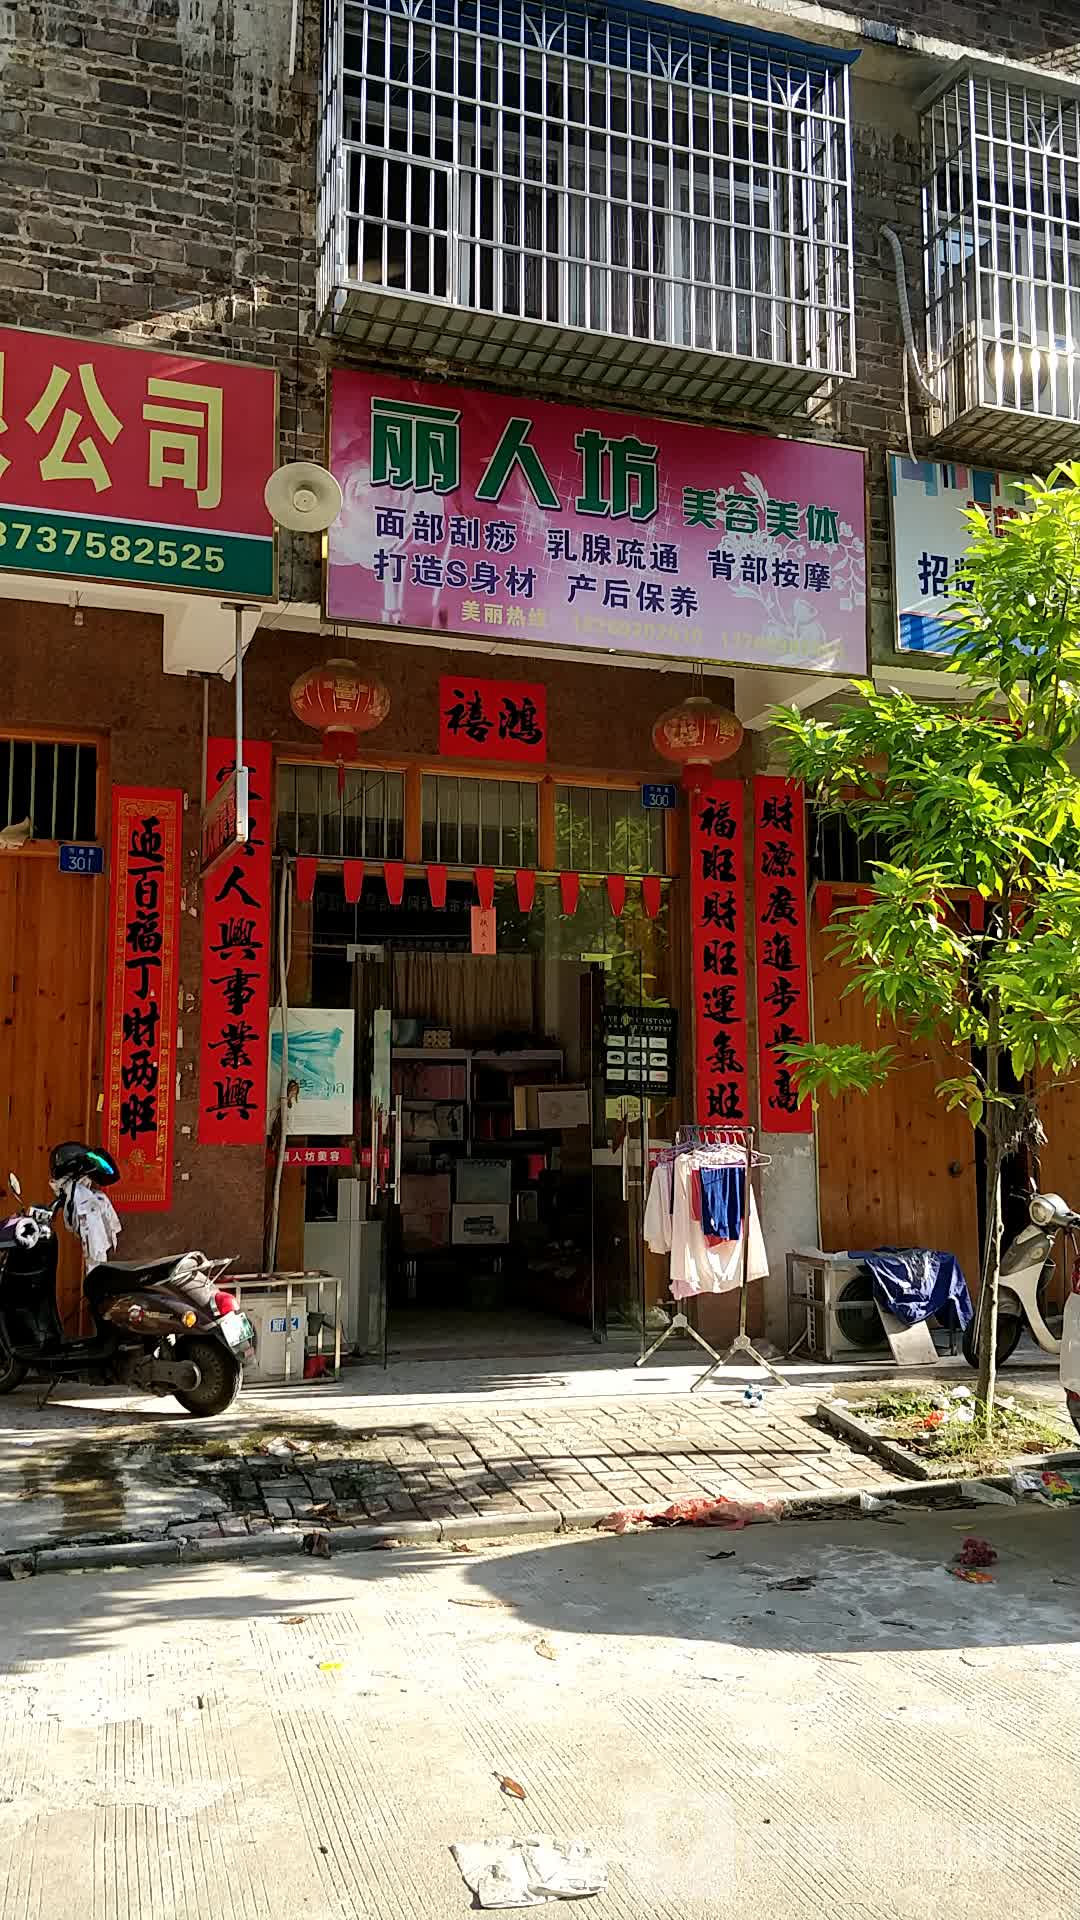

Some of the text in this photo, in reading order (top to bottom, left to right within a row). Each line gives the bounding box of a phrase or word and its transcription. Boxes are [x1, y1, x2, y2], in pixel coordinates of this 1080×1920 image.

[370, 396, 659, 523] 丽人坊
[373, 505, 833, 594] 面部刮痧 乳腺疏通 背部按摩
[683, 487, 840, 545] 美容美体
[373, 547, 700, 619] 打造S身材 产后保养
[68, 856, 92, 872] 301
